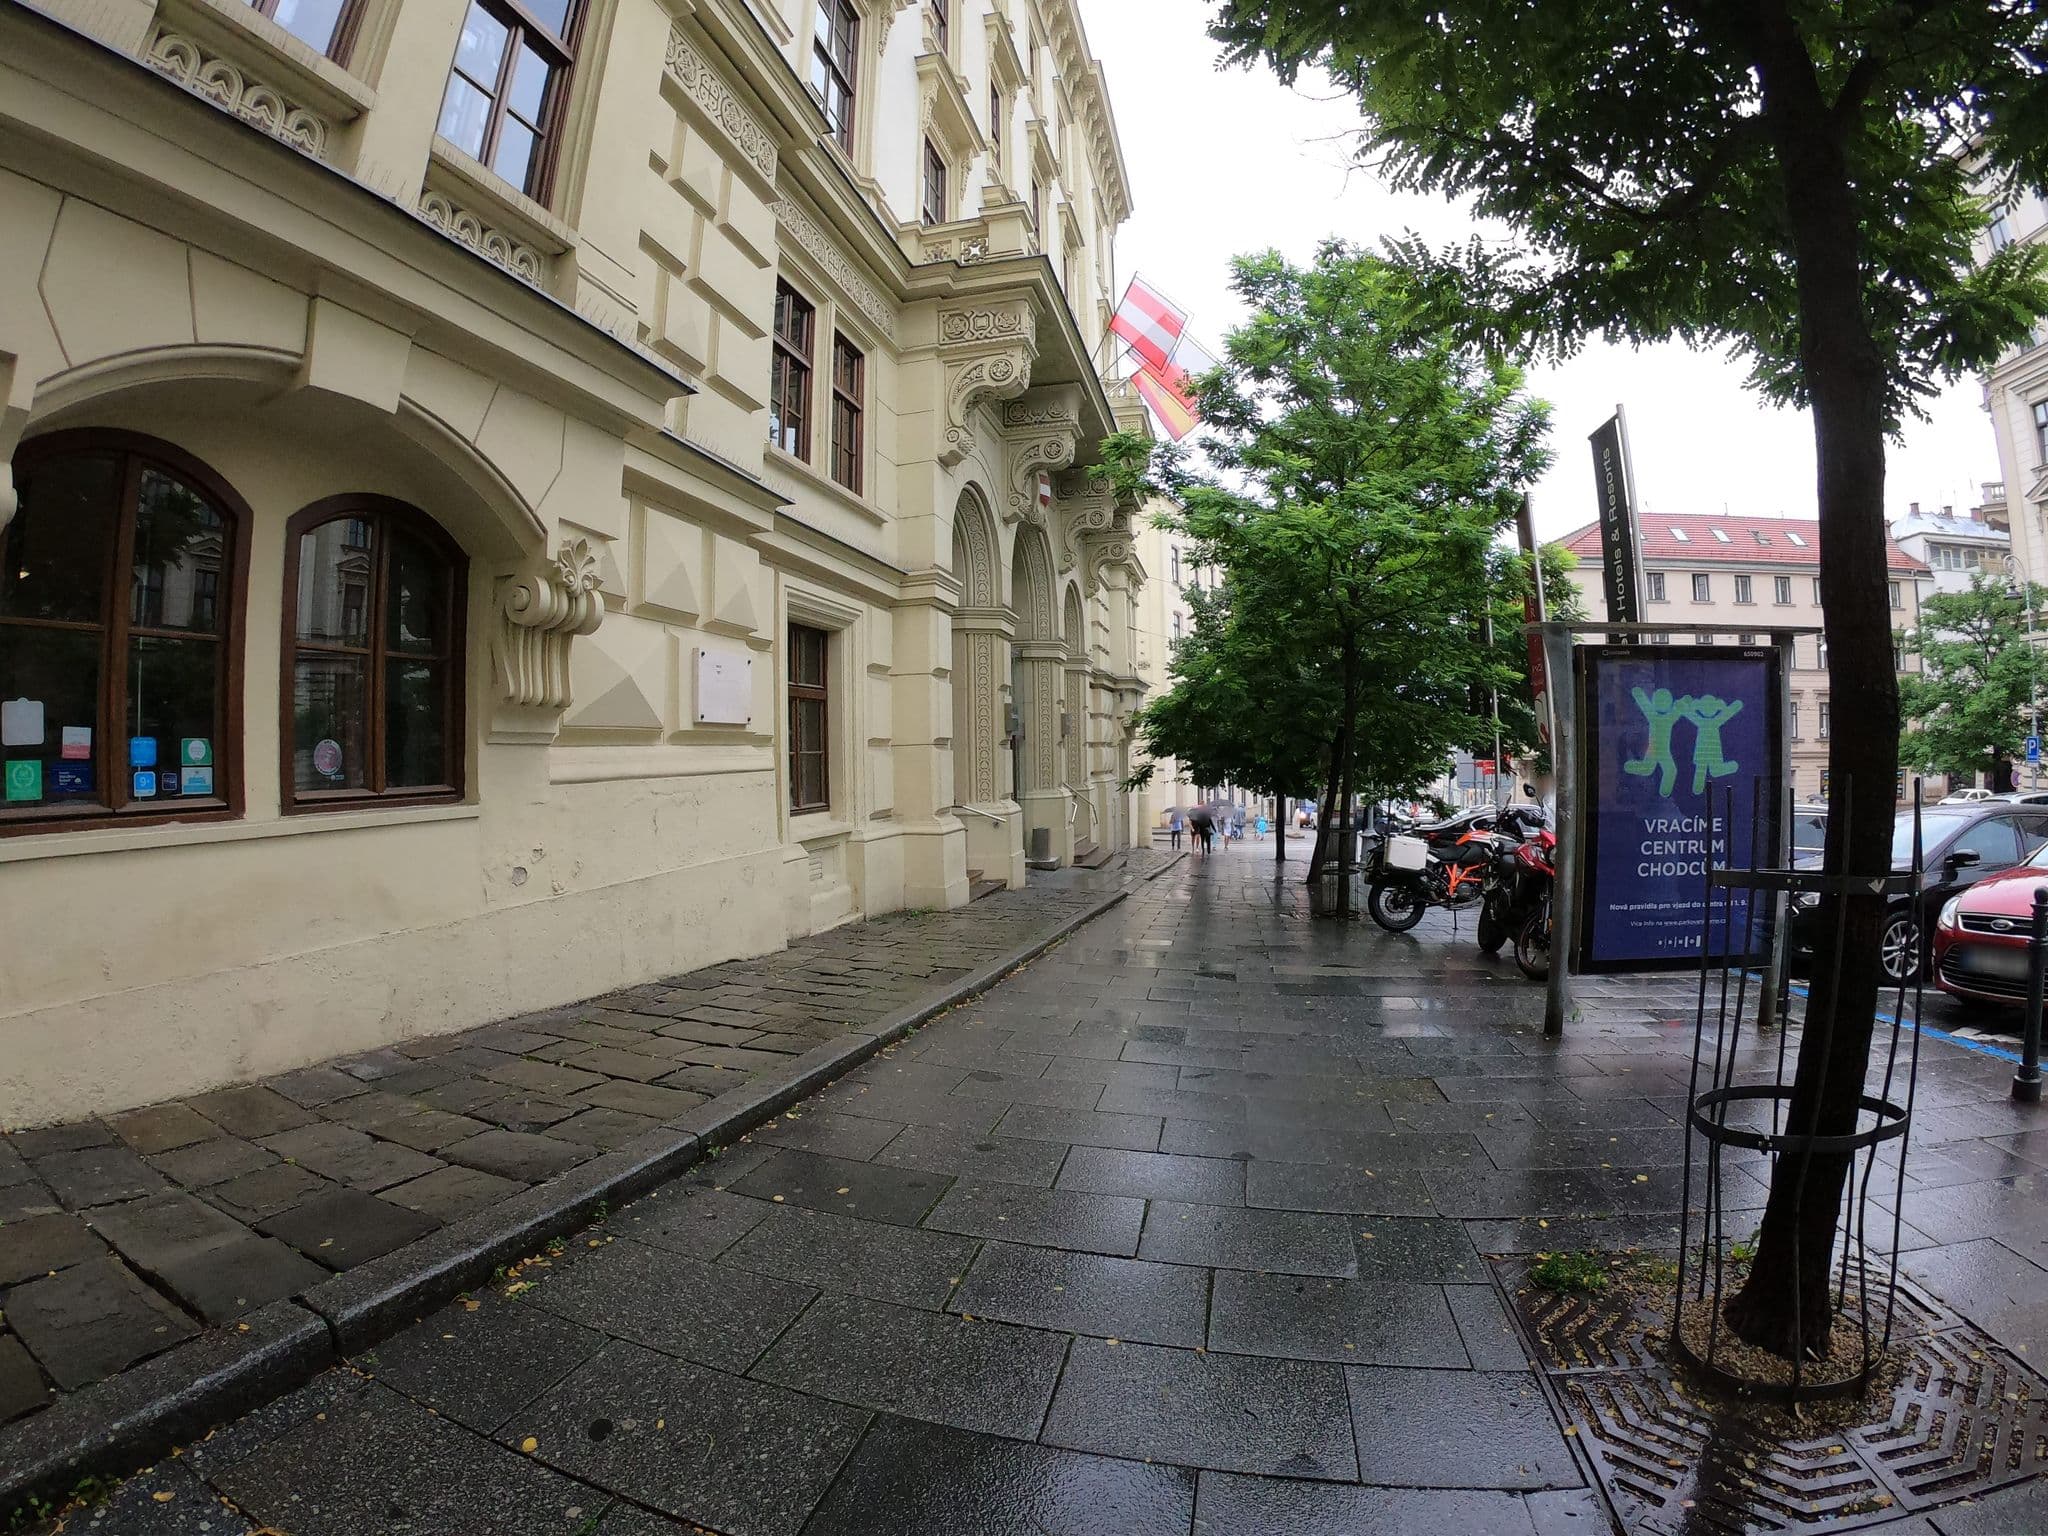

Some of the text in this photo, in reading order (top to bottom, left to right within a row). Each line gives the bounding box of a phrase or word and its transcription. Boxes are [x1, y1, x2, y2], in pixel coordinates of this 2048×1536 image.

[1602, 447, 1618, 522] Resorts
[1610, 528, 1620, 542] &
[1612, 548, 1627, 611] Hotels
[2028, 740, 2036, 754] P
[1644, 815, 1722, 833] VRACÍME
[1640, 839, 1724, 856] CENTRUM
[1629, 902, 1657, 911] pravidla
[1658, 902, 1671, 910] pro
[1672, 900, 1691, 910] vjezd
